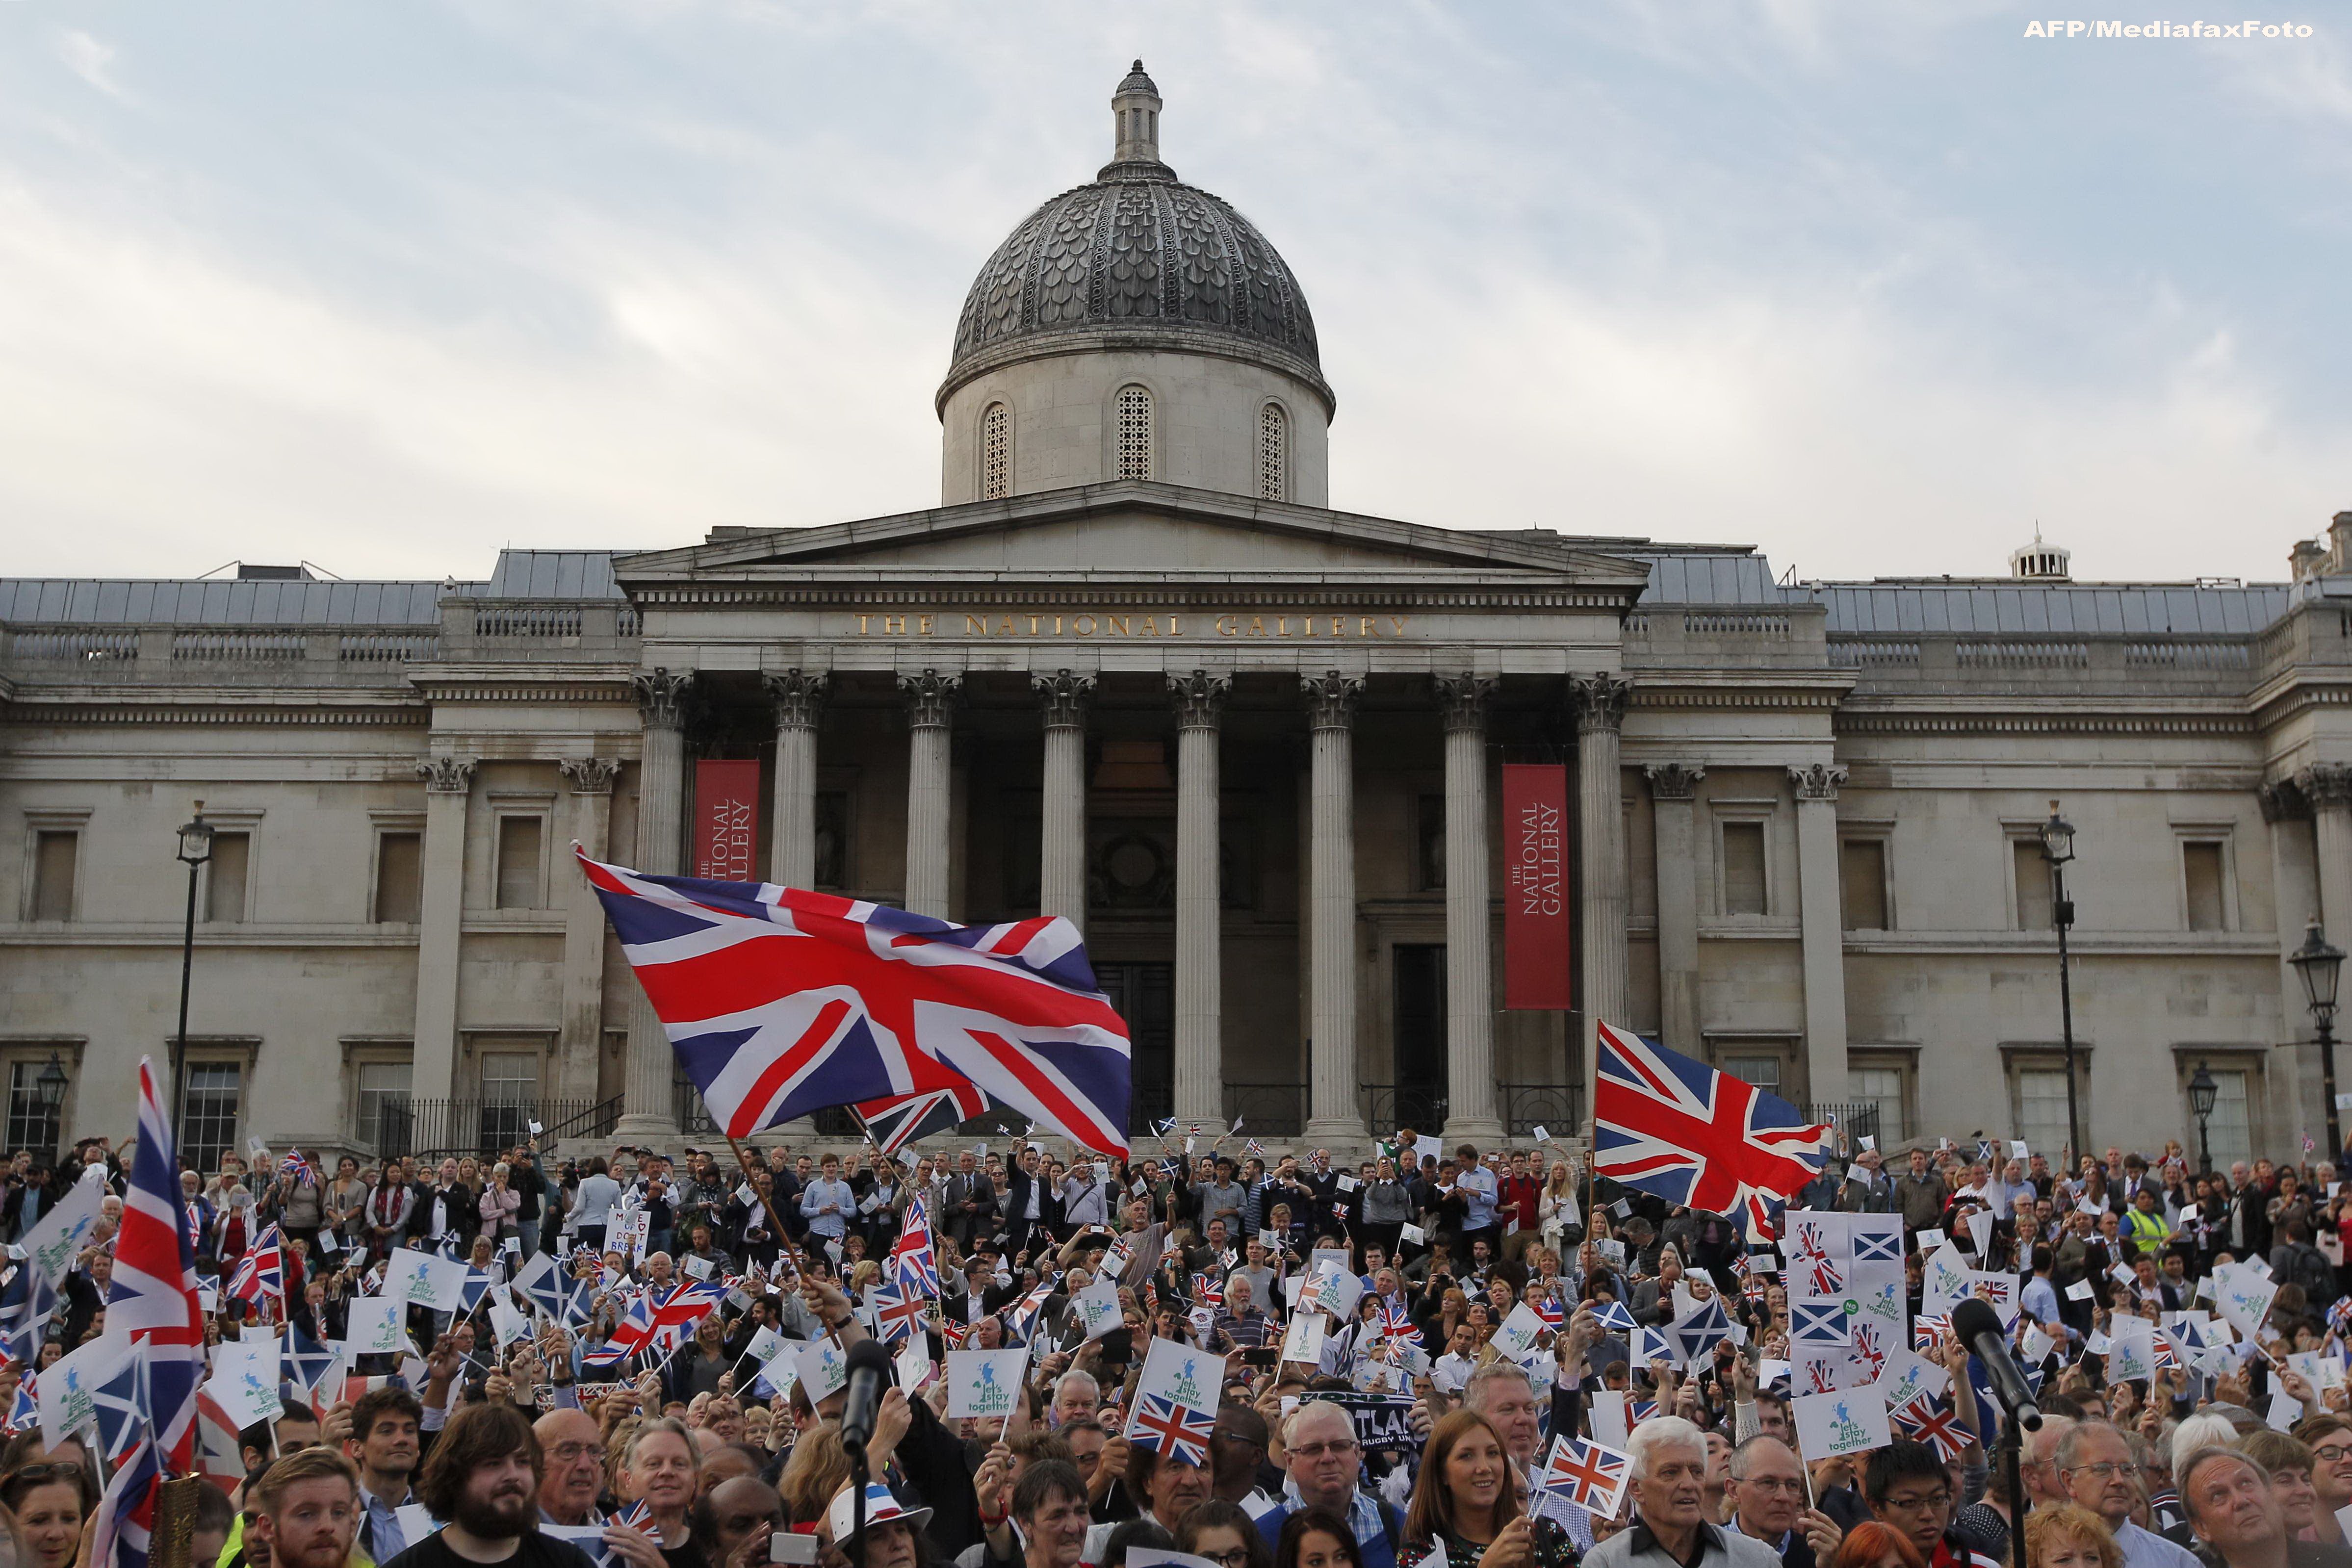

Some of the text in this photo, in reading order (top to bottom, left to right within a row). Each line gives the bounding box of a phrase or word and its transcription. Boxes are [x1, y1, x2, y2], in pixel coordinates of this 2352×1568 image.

[853, 615, 1410, 637] THE NATIONAL GALLERY
[711, 798, 729, 882] TIONAL
[730, 799, 750, 882] LLERY
[1523, 802, 1538, 915] NATIONAL
[1541, 803, 1561, 916] GALLERY
[616, 1213, 643, 1222] ME
[408, 1291, 437, 1304] gether
[1318, 1295, 1341, 1311] gether
[1085, 1300, 1093, 1327] together
[1866, 1303, 1900, 1322] together
[986, 1393, 1009, 1402] stay
[1164, 1389, 1203, 1407] together
[969, 1401, 1009, 1413] togethe
[1362, 1434, 1394, 1446] RUGBY
[1845, 1428, 1866, 1438] stay
[1829, 1437, 1871, 1451] together
